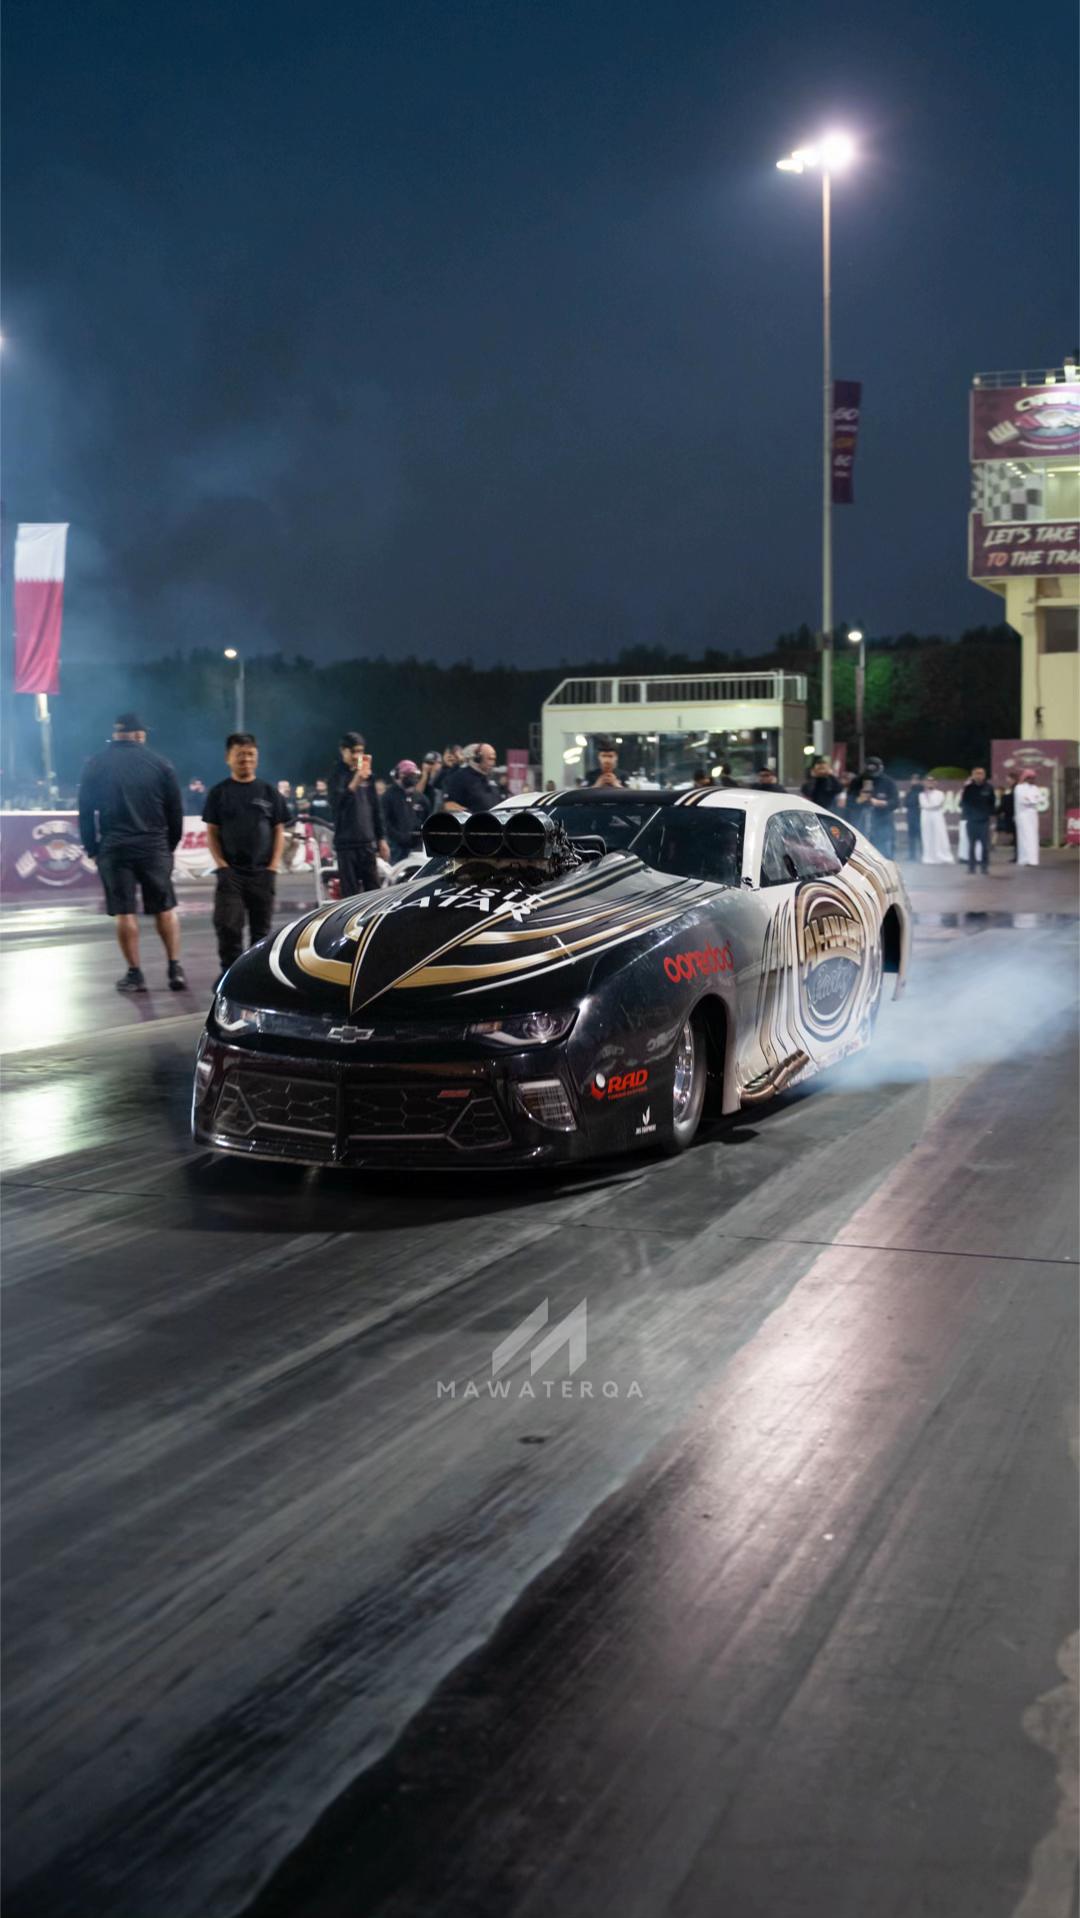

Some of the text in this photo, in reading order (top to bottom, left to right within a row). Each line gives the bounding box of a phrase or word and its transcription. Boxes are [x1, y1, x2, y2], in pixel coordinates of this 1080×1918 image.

[983, 526, 1078, 547] LET'S TAKE
[986, 549, 1080, 567] TO THE TRA
[664, 941, 734, 983] ooredoo
[608, 1069, 648, 1093] RAD
